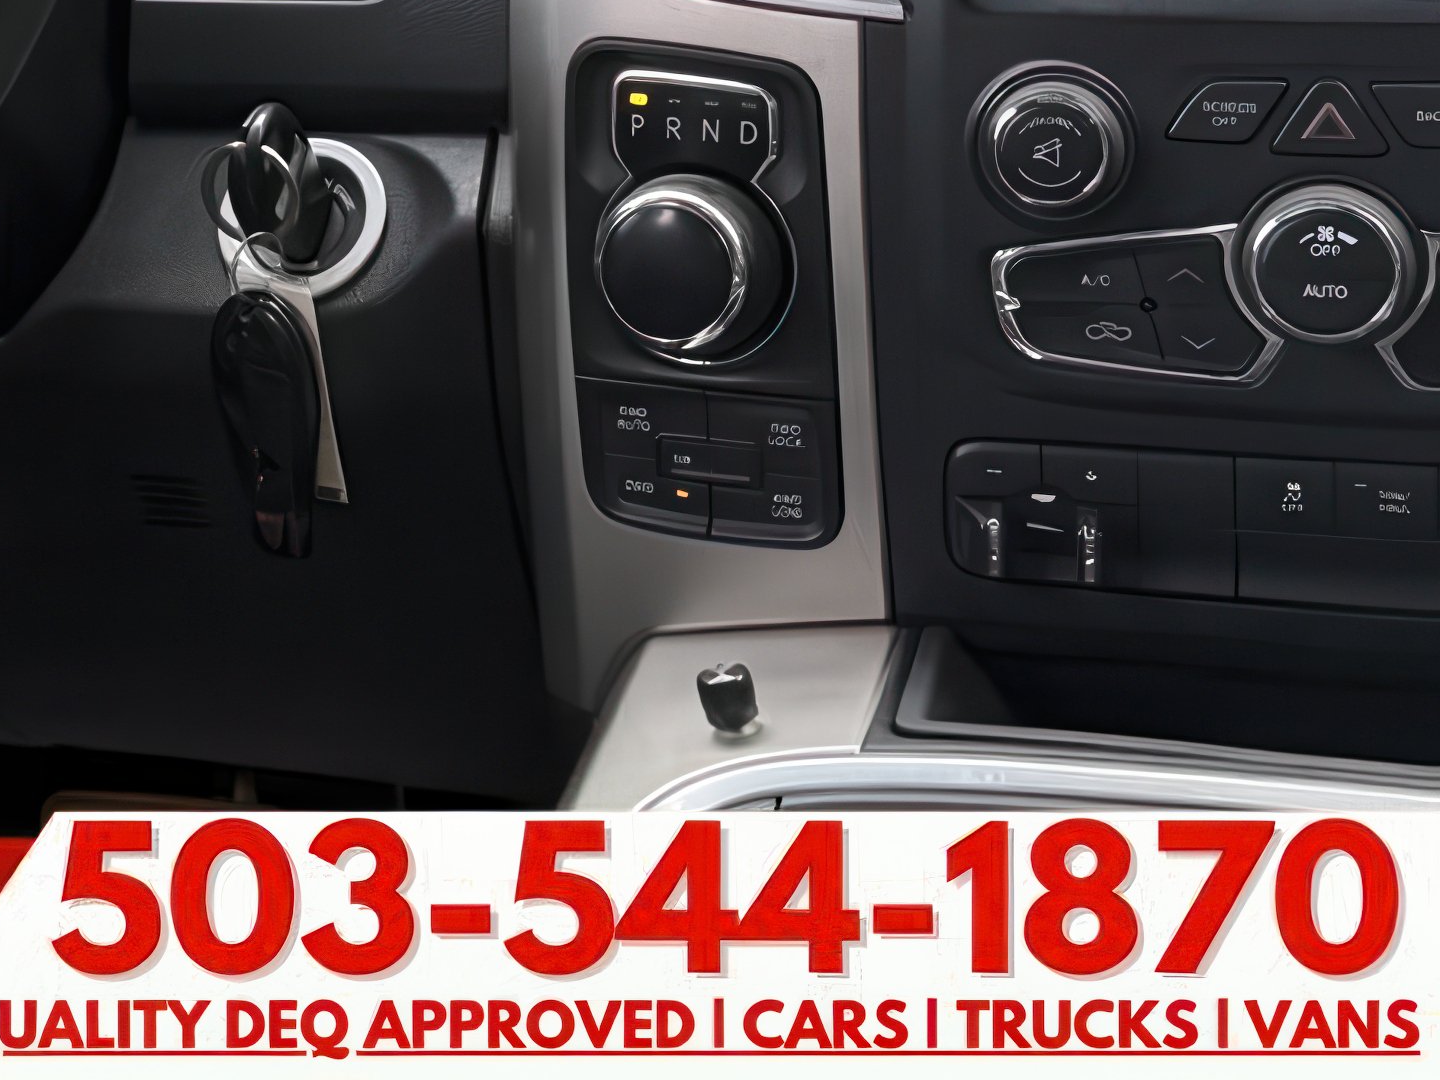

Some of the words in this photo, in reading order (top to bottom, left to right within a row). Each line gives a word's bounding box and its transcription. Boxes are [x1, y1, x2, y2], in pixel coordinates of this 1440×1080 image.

[630, 114, 646, 137] P
[665, 117, 682, 141] R
[702, 119, 721, 144] N
[739, 121, 759, 146] D
